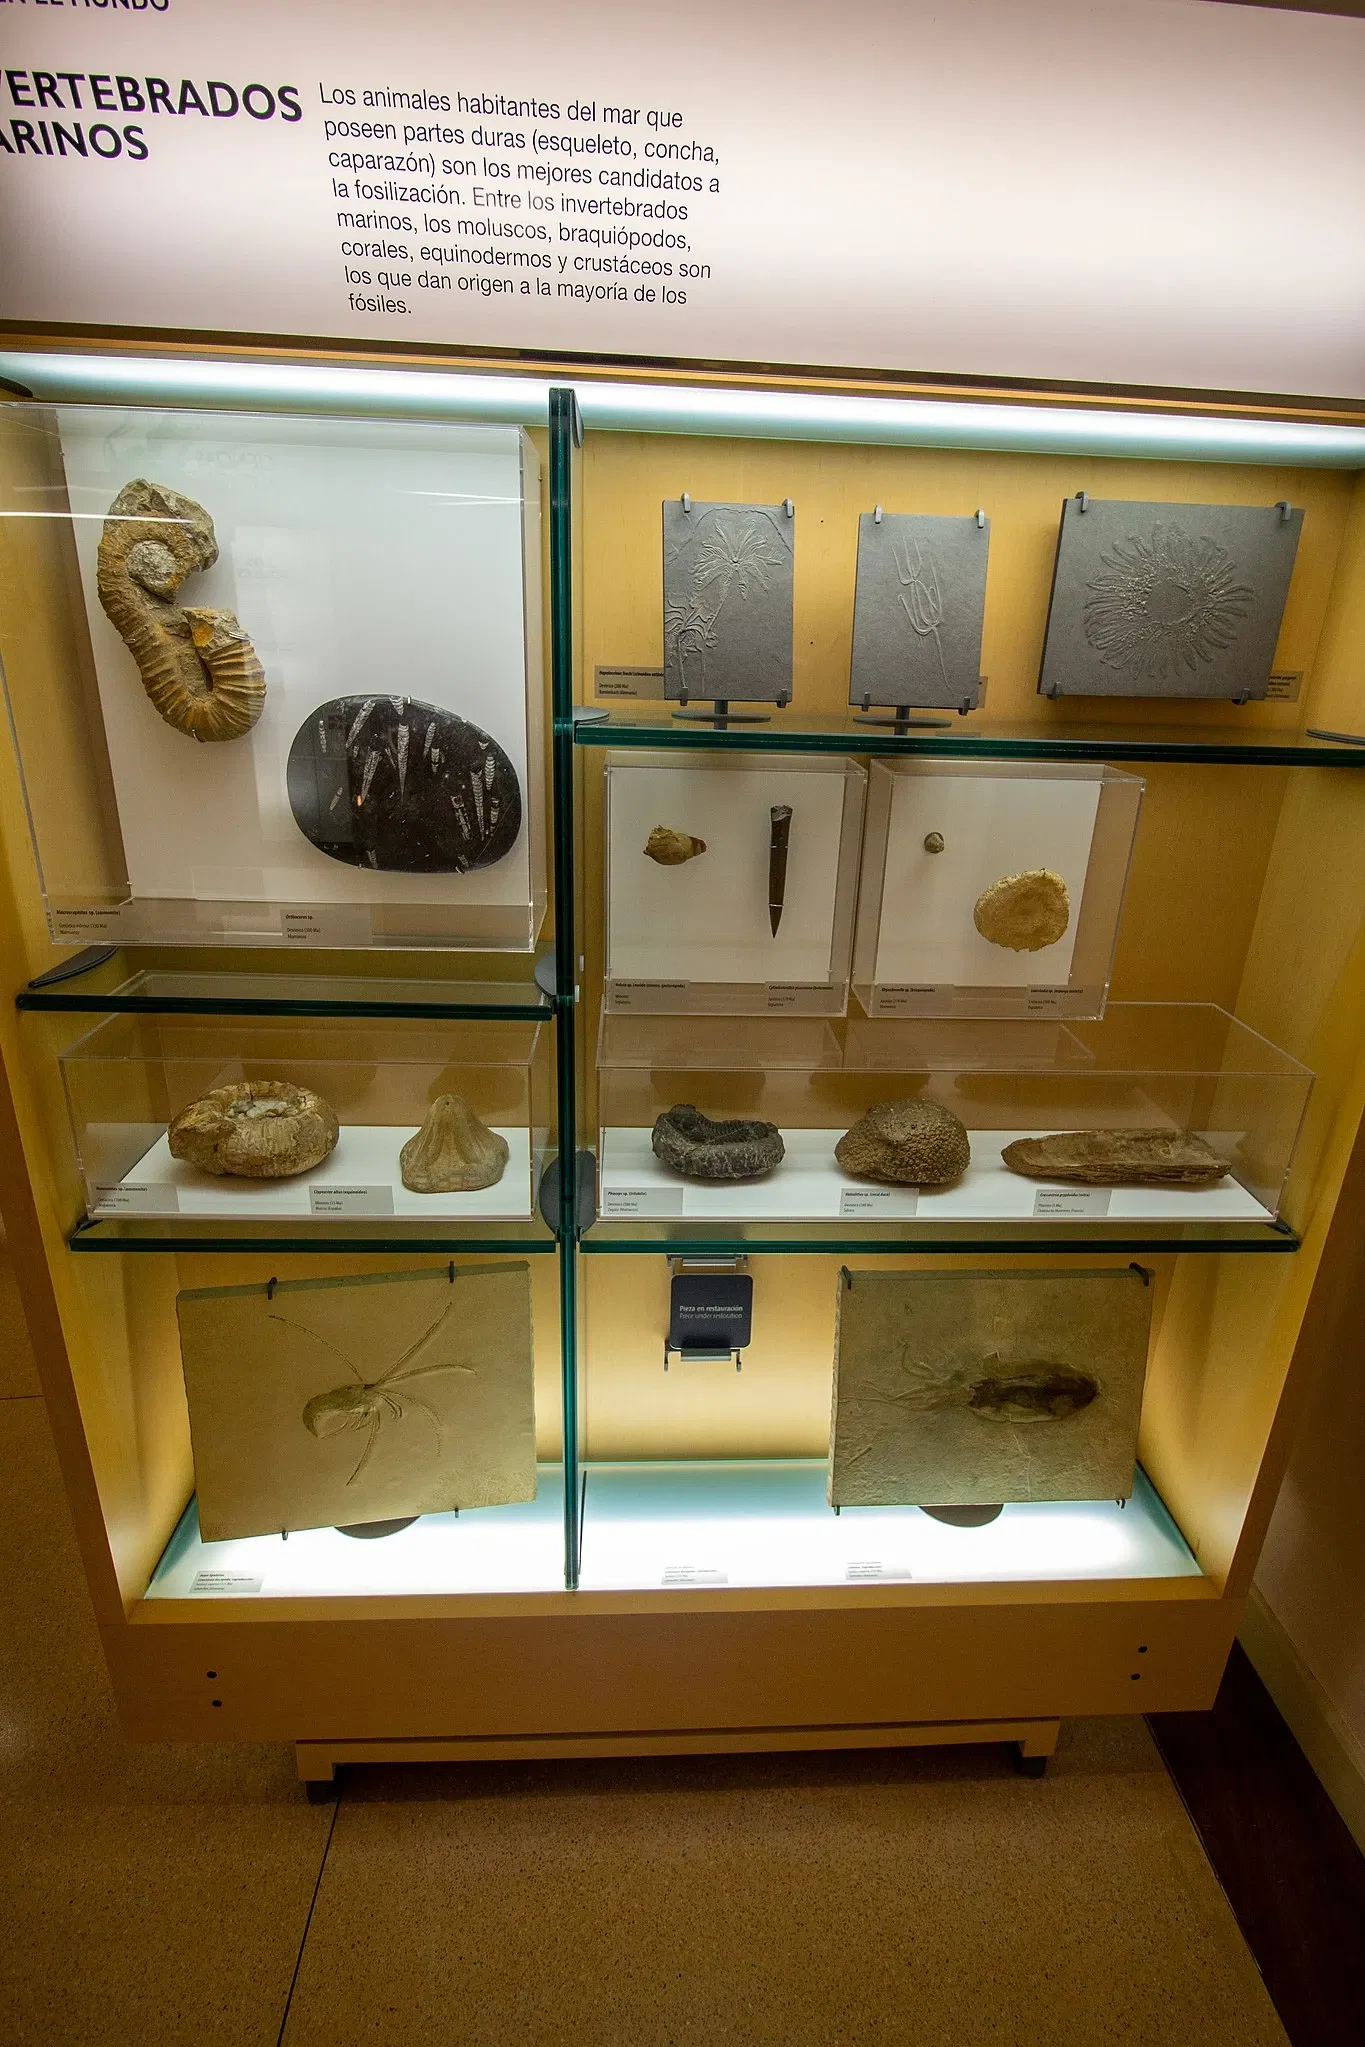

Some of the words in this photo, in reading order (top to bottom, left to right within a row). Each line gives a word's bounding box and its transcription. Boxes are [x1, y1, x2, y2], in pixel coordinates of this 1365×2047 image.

[0, 69, 303, 122] ERTEBRADOS
[318, 81, 357, 106] Los
[362, 86, 451, 112] animales
[457, 91, 561, 120] habitantes
[567, 99, 596, 122] del
[603, 107, 641, 125] mar
[646, 110, 683, 132] que
[323, 120, 397, 142] poseen
[403, 123, 465, 146] partes
[471, 124, 526, 149] duras
[532, 128, 637, 160] (esqueleto,
[644, 140, 719, 166] concha,
[328, 151, 436, 179] caparazón)
[441, 159, 477, 177] son
[483, 156, 511, 179] los
[517, 161, 593, 187] mejores
[598, 167, 703, 192] candidatos
[708, 177, 720, 194] a
[331, 177, 350, 199] la
[353, 178, 466, 206] fosilización.
[472, 186, 522, 209] Entre
[527, 190, 555, 212] los
[561, 192, 689, 221] invertebrados
[336, 209, 418, 235] marinos,
[423, 212, 452, 234] los
[457, 217, 552, 244] moluscos,
[558, 221, 691, 253] braquiópodos,
[341, 239, 414, 263] corales,
[420, 243, 552, 269] equinodermos
[557, 255, 568, 274] y
[573, 254, 673, 277] crustáceos
[678, 263, 711, 279] son
[344, 264, 372, 285] los
[377, 271, 412, 291] que
[417, 269, 452, 290] dan
[457, 273, 514, 297] origen
[519, 280, 531, 295] a
[536, 276, 552, 297] la
[557, 281, 629, 303] mayoría
[633, 283, 656, 303] de
[662, 285, 687, 305] los
[347, 292, 412, 314] fósiles.
[706, 1304, 744, 1312] restauración
